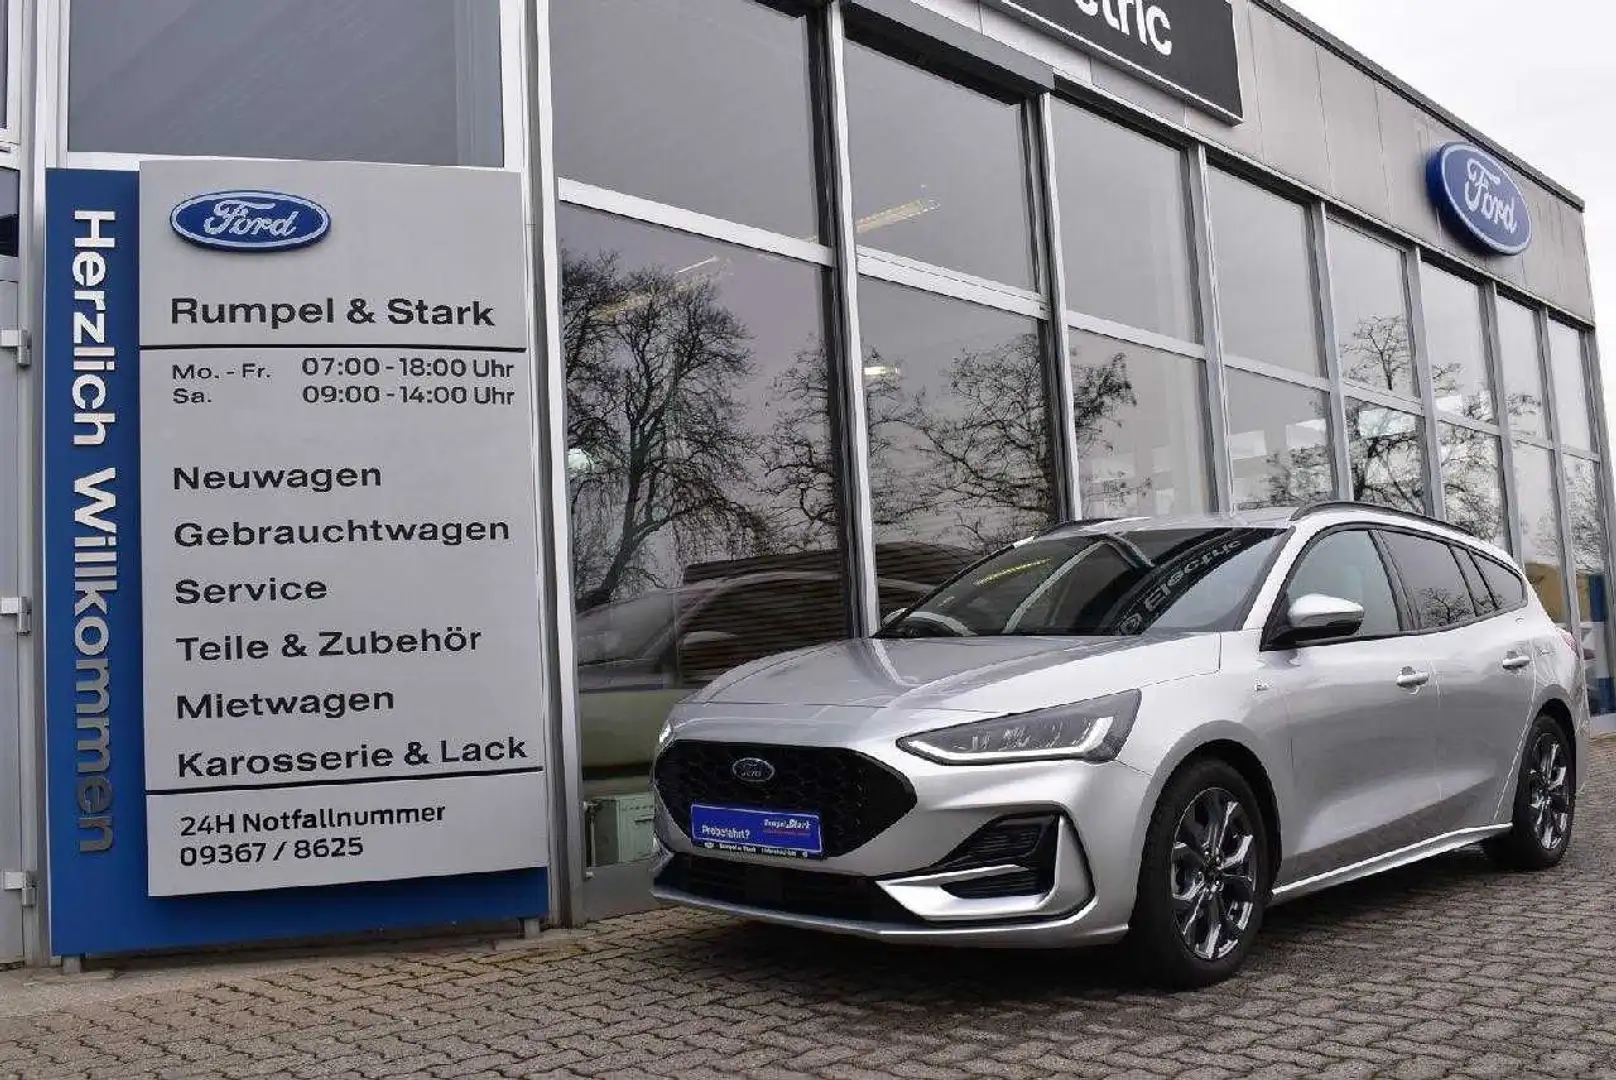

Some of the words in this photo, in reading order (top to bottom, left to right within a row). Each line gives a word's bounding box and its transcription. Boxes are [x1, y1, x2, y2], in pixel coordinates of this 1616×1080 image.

[1464, 158, 1518, 234] Ford
[203, 199, 299, 237] Ford
[72, 209, 117, 446] Herzlich
[171, 297, 334, 330] Rumpel
[346, 298, 376, 325] &
[387, 298, 496, 326] Stark
[172, 364, 220, 380] Mo.
[242, 362, 271, 378] Fr.
[301, 356, 380, 376] 07:00
[399, 357, 467, 377] 18:00
[472, 358, 515, 378] Uhr
[172, 387, 212, 405] Sa.
[302, 385, 380, 404] 09:00
[399, 386, 467, 404] 14:00
[473, 386, 515, 405] Uhr
[173, 466, 382, 493] Neuwagen
[174, 519, 509, 548] Gebrauchtwagen
[175, 577, 327, 605] Service
[73, 466, 118, 855] Willkommen
[175, 635, 269, 662] Teile
[281, 633, 308, 658] &
[318, 626, 482, 657] Zubehör
[176, 689, 395, 720] Mietwagen
[177, 744, 395, 778] Karosserie
[403, 741, 430, 767] &
[440, 735, 528, 763] Lack
[180, 813, 235, 837] 24H
[242, 804, 447, 835] Notfallnummer
[180, 842, 267, 867] 09367
[272, 841, 288, 862] /
[293, 836, 364, 860] 8625
